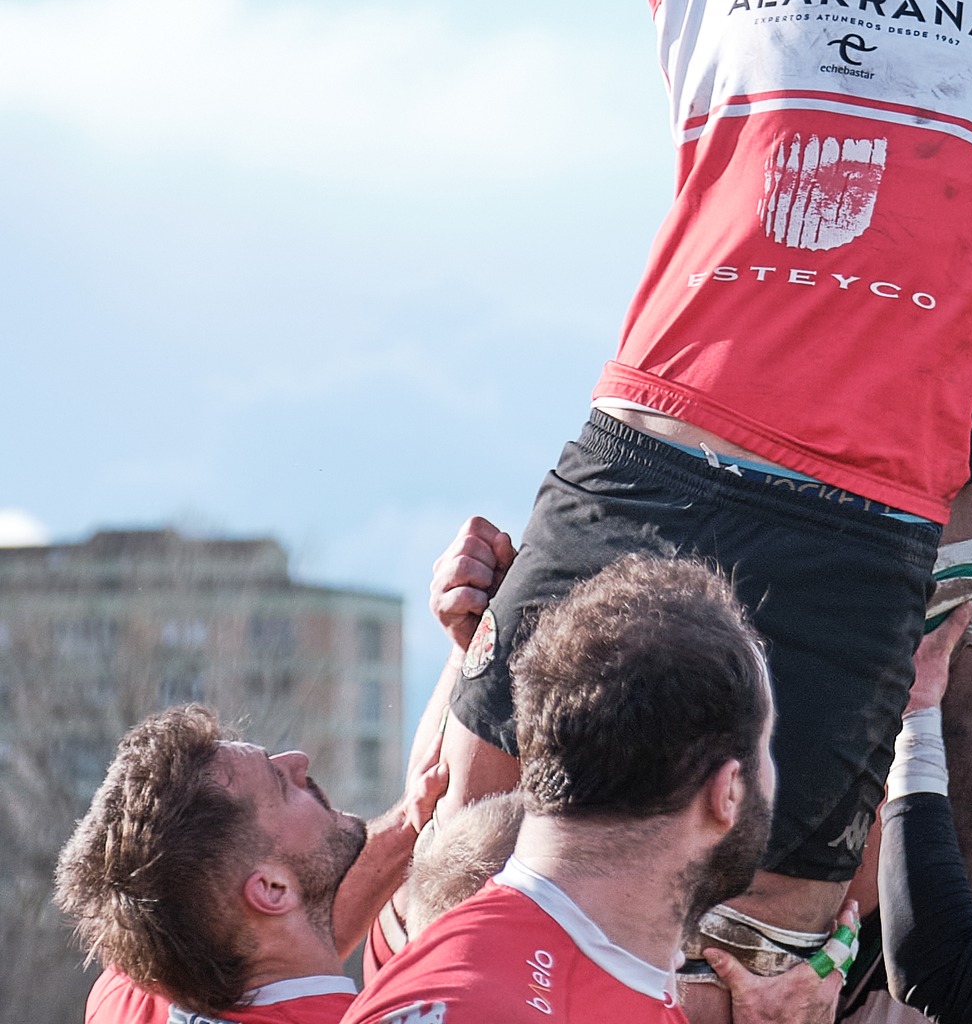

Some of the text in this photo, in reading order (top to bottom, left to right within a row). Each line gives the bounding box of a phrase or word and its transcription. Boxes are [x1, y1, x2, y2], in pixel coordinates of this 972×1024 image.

[754, 13, 961, 46] EXPERTOS ATUNEROS DESDE 1967
[819, 63, 875, 80] echebastar
[687, 264, 937, 310] ESTEYCO
